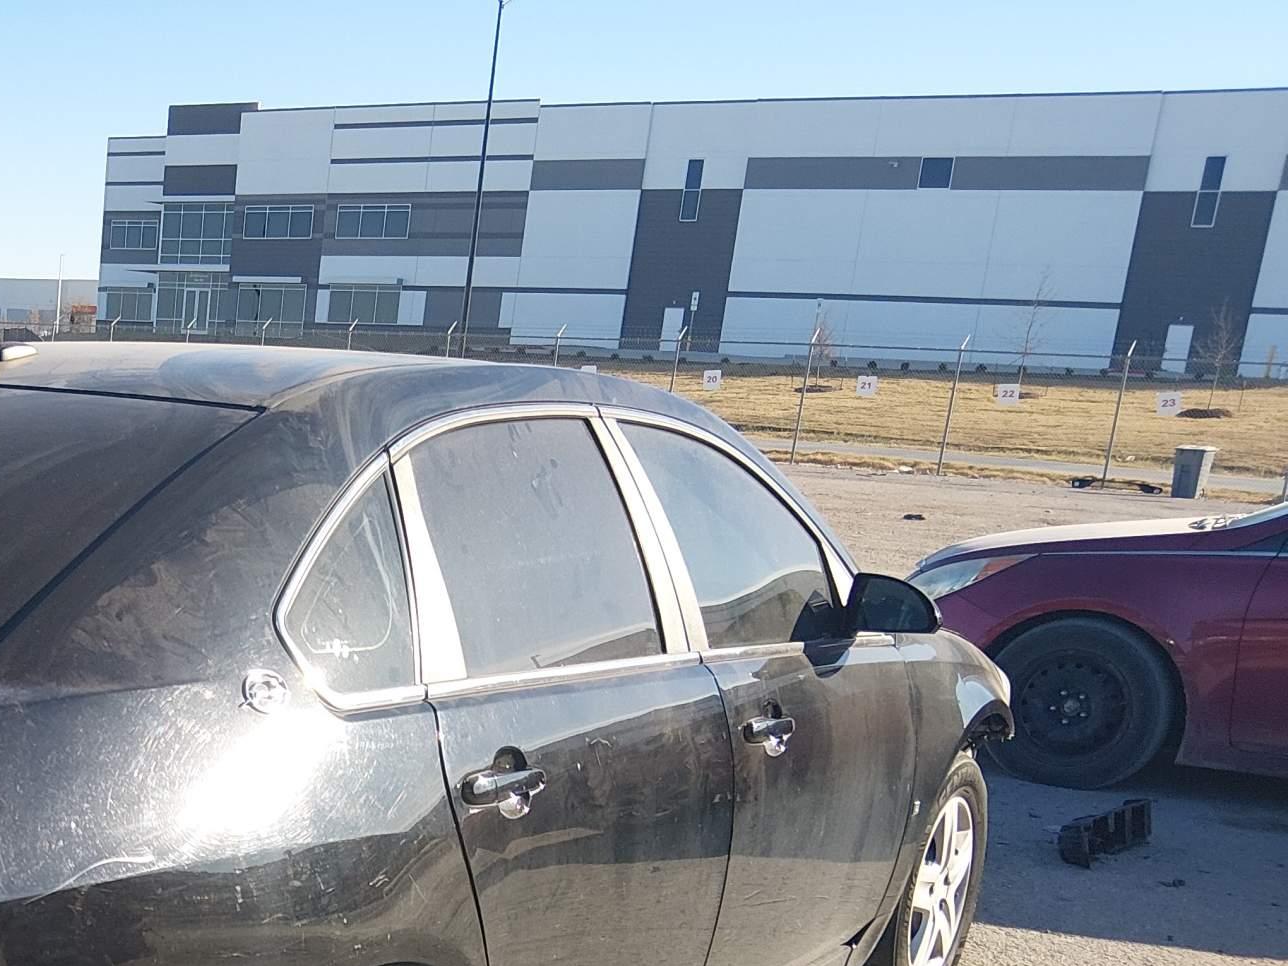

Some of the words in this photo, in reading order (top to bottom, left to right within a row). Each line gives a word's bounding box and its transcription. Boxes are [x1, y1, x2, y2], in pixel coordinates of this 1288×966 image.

[706, 375, 718, 384] 20
[860, 381, 872, 390] 21
[1001, 390, 1015, 398] 22
[1160, 398, 1177, 408] 23
